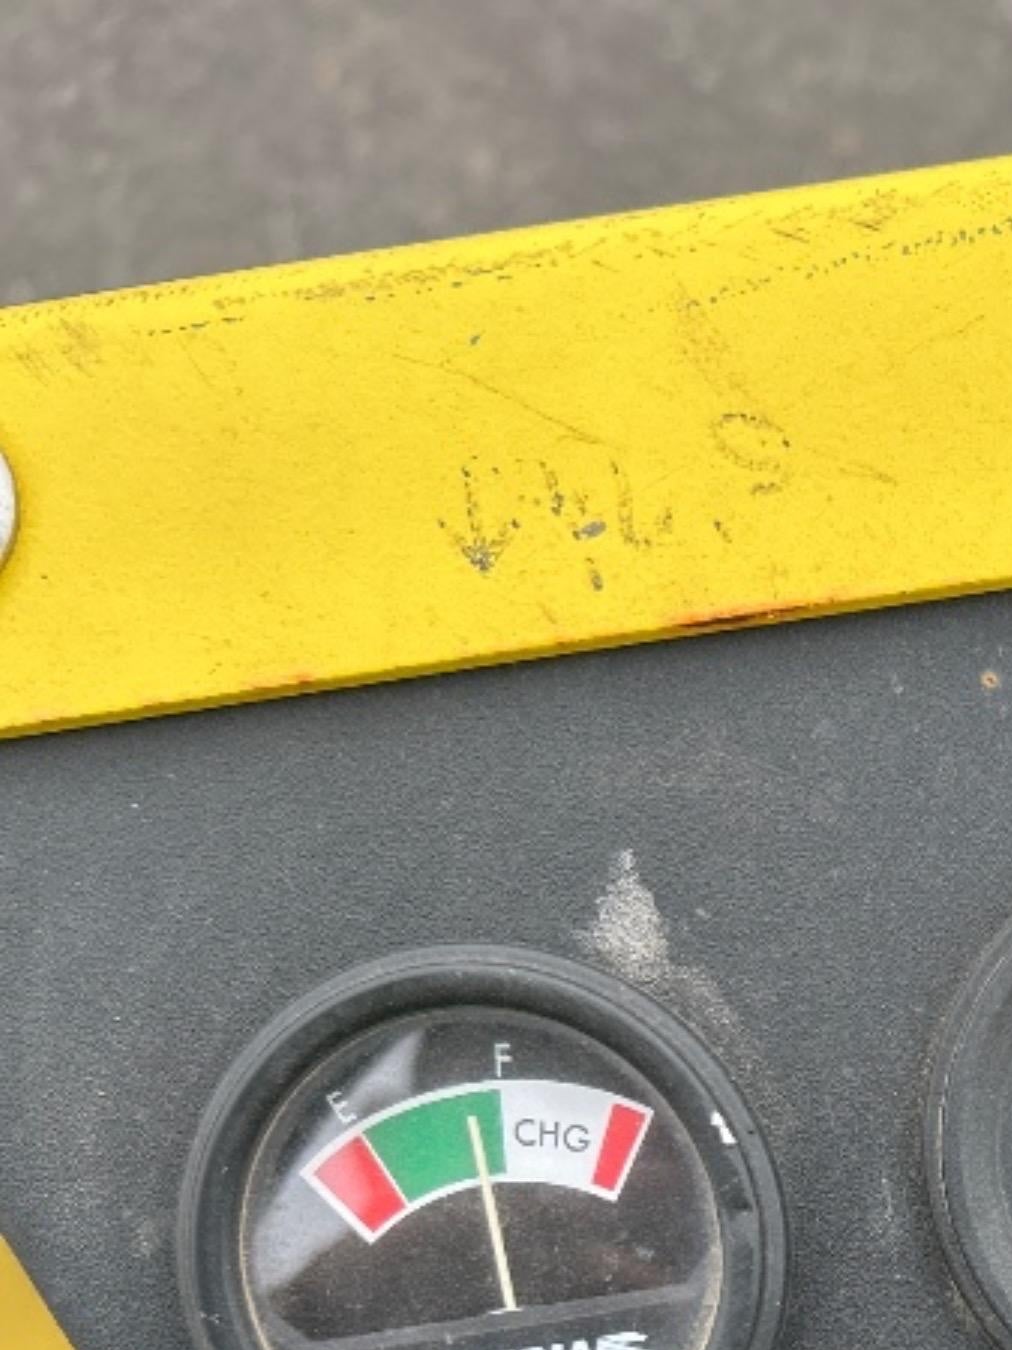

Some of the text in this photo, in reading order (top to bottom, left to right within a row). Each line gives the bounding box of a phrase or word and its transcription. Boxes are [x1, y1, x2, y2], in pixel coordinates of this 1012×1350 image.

[493, 1043, 512, 1077] F
[326, 1089, 358, 1125] E
[514, 1118, 591, 1152] CHG
